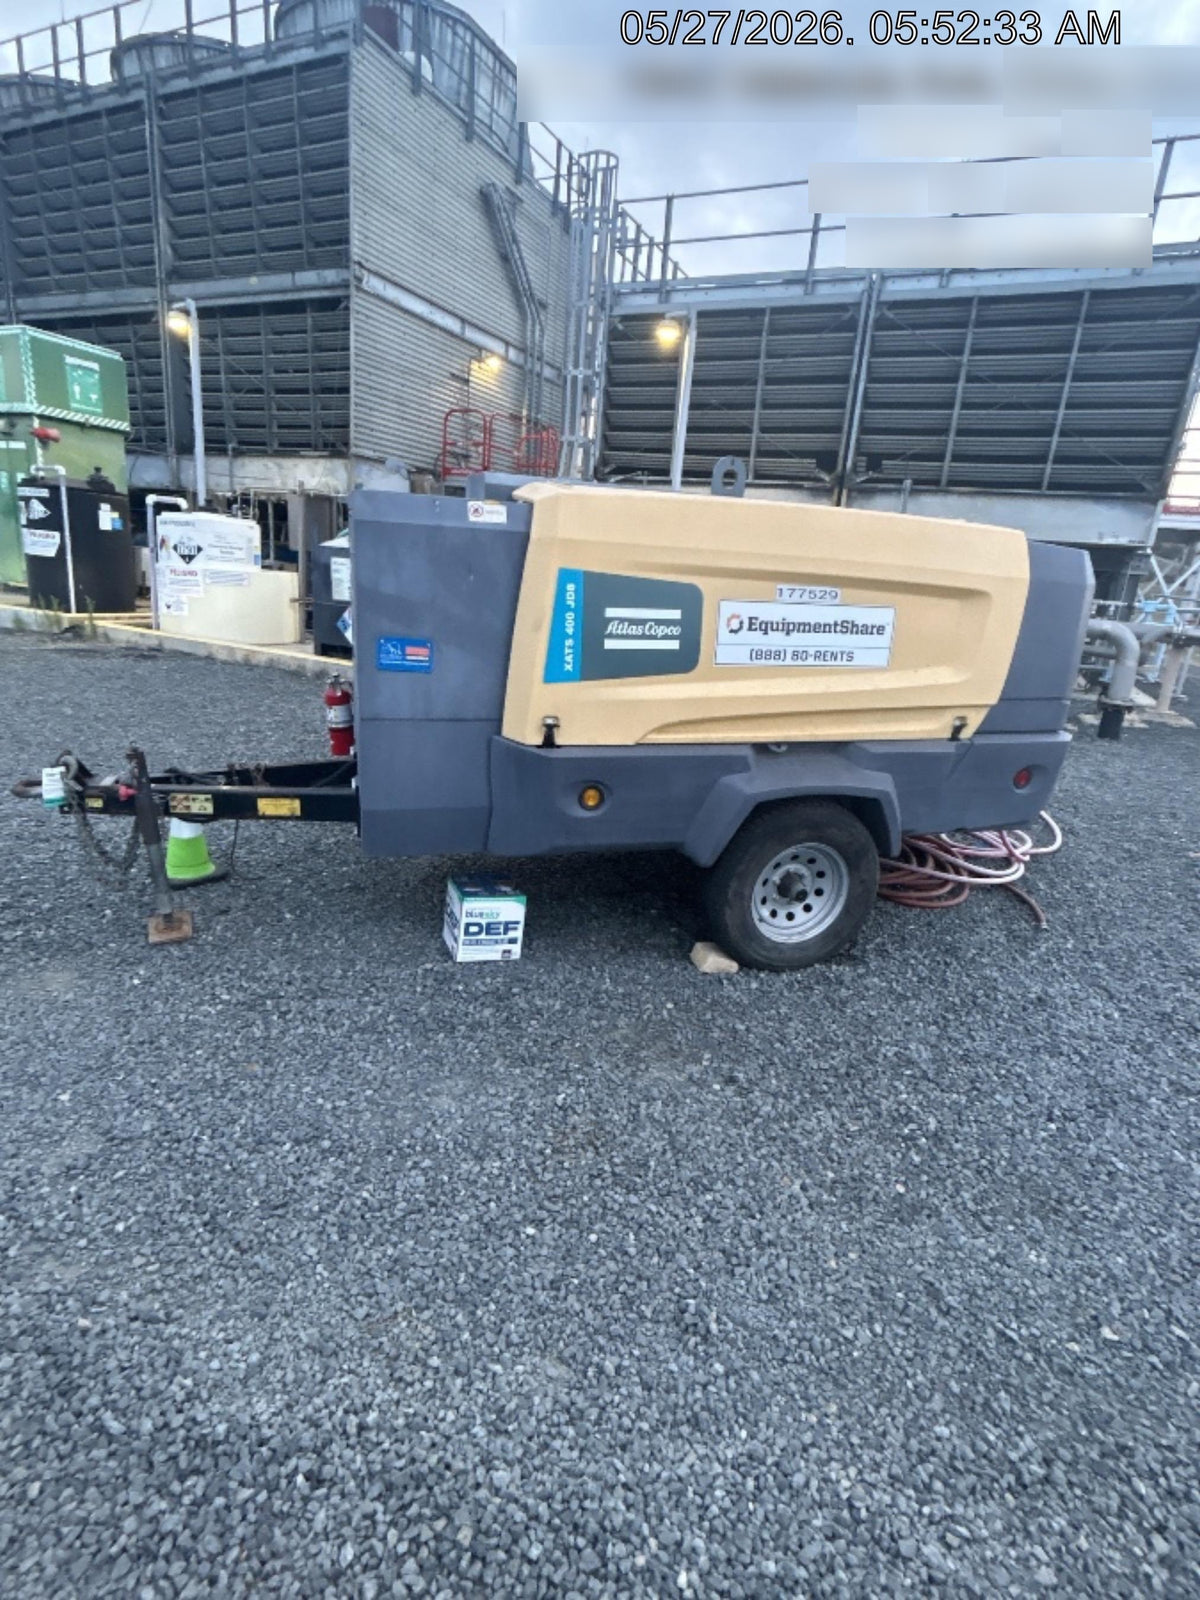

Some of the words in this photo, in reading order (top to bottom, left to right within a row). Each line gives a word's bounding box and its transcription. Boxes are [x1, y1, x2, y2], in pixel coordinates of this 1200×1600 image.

[776, 587, 839, 600] 177529
[565, 611, 575, 635] 400
[604, 620, 643, 635] Atlas
[644, 621, 681, 639] Copco
[747, 616, 886, 637] EquipmentShare
[564, 639, 574, 672] XATS
[750, 648, 787, 662] (888)
[464, 921, 520, 937] DEF
